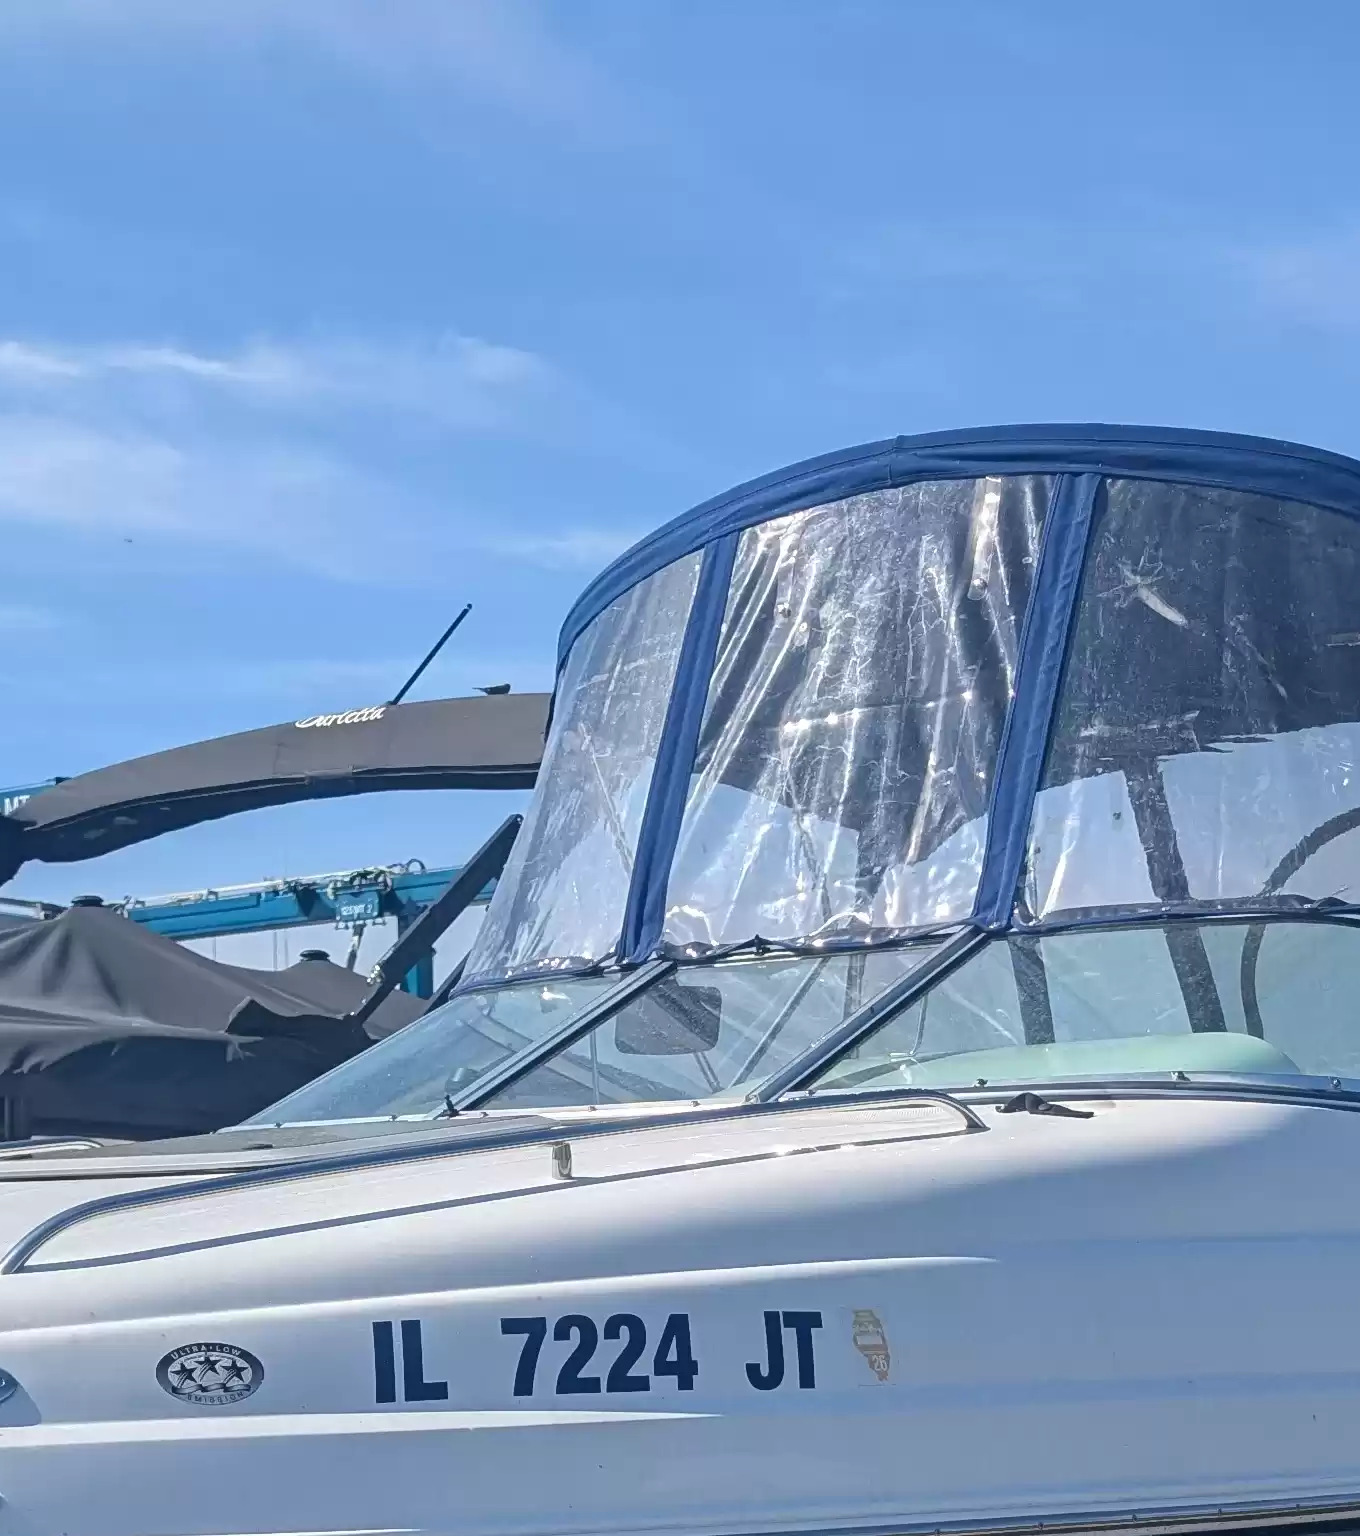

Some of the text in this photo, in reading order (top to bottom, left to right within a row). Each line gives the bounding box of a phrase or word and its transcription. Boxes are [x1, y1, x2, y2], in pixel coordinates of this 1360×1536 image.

[170, 1344, 242, 1360] ULTRA LOW
[371, 1310, 823, 1404] IL 7224 JT
[871, 1354, 888, 1372] 26
